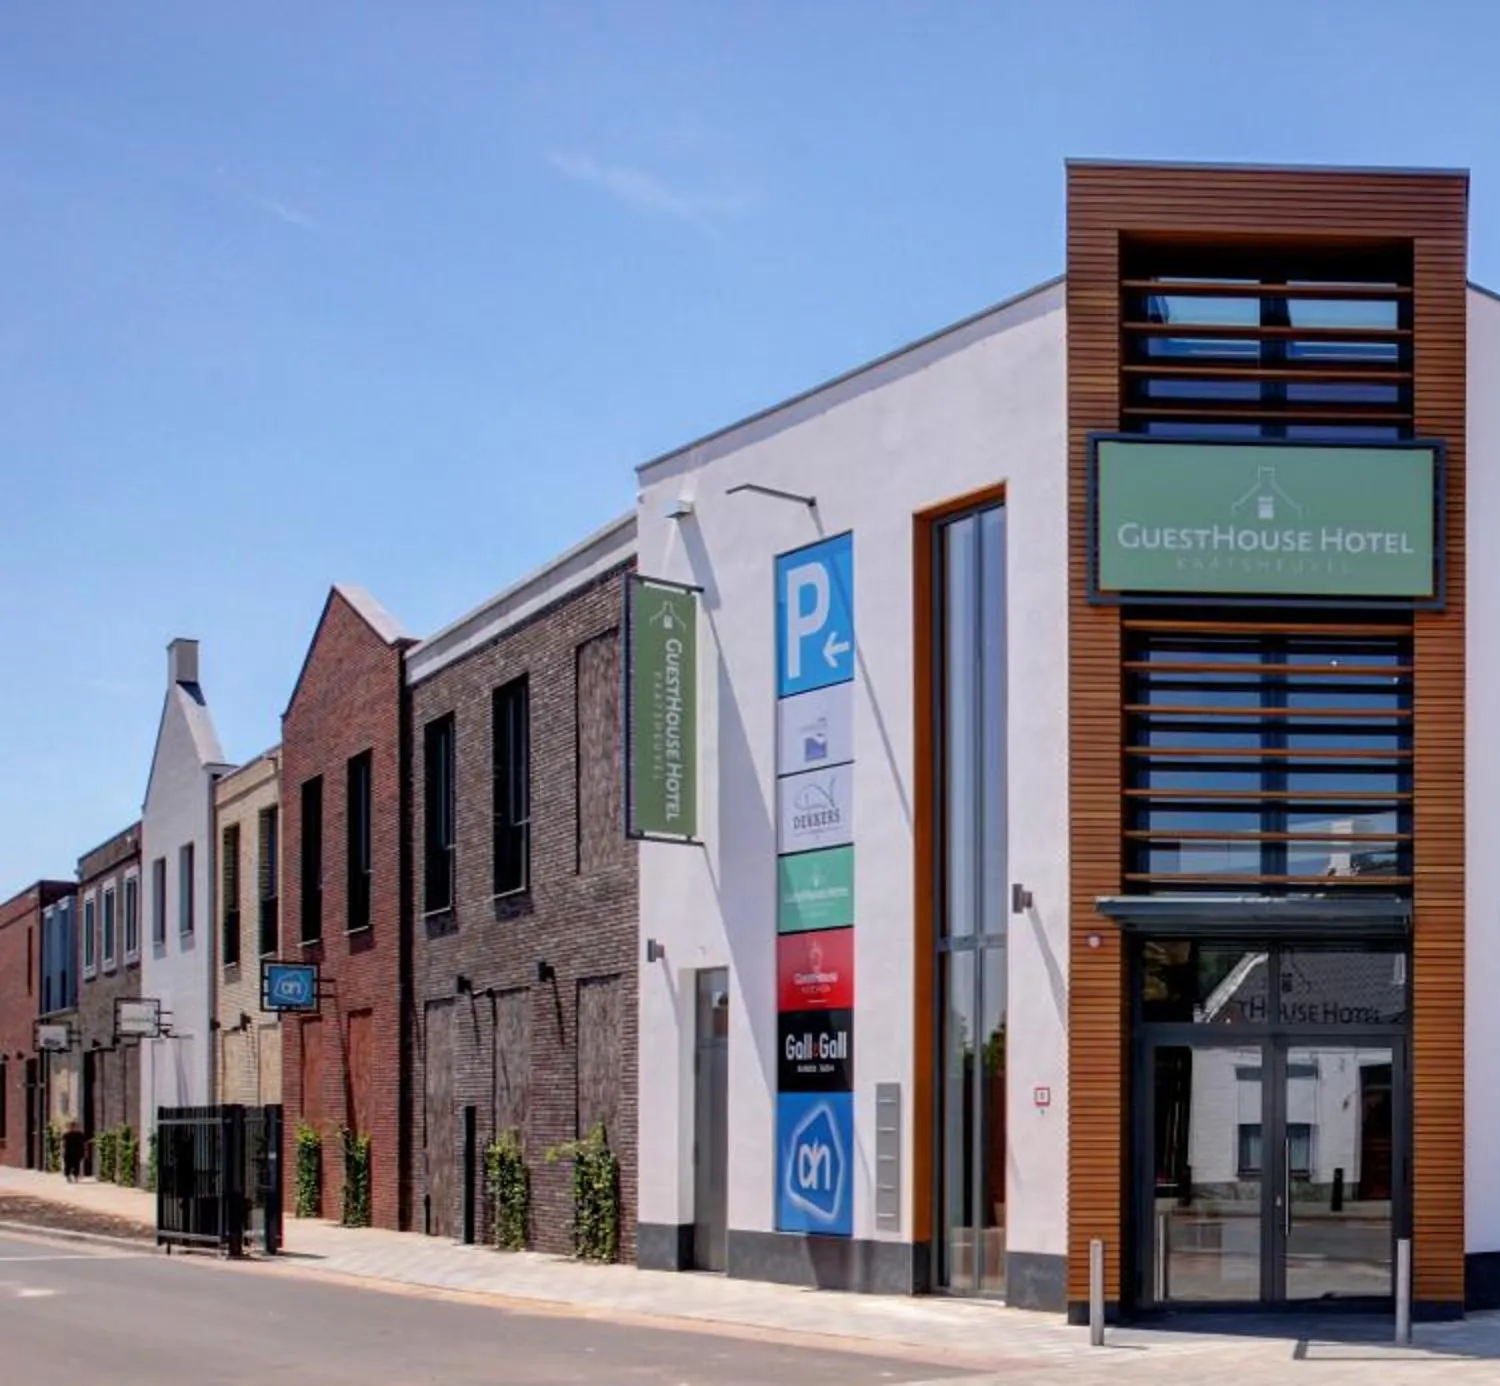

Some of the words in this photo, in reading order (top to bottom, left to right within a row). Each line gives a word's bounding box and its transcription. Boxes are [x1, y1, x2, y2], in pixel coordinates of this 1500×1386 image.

[1117, 521, 1312, 552] GUESTHOUSE
[1321, 527, 1415, 554] HOTEL
[787, 561, 831, 680] P
[665, 638, 684, 760] GUESTHOUSE
[665, 763, 684, 821] HOTEL
[793, 807, 841, 830] DEKKERS
